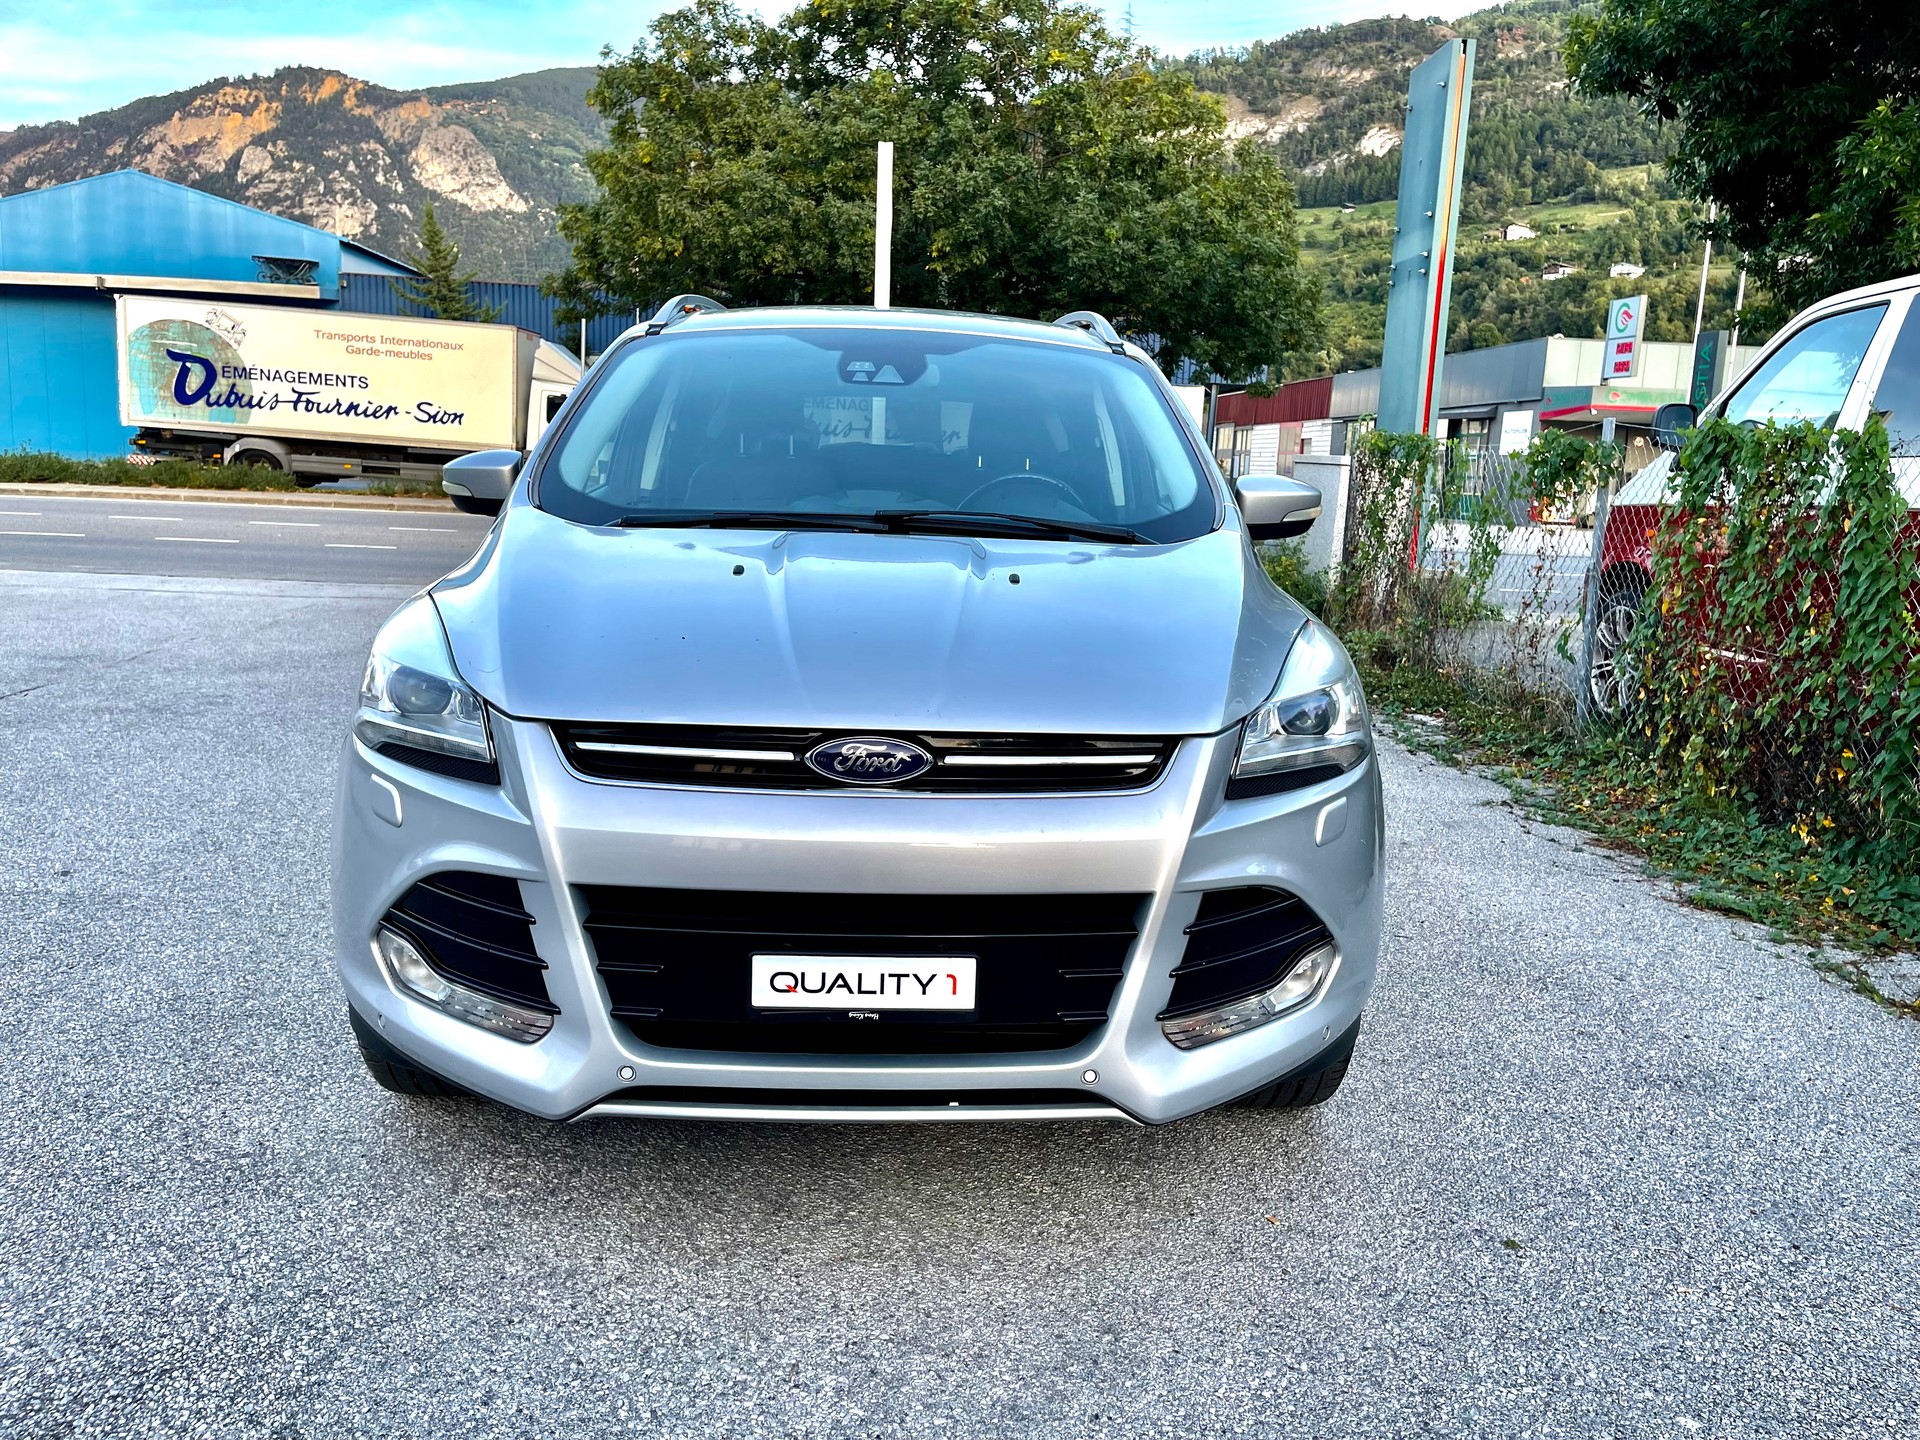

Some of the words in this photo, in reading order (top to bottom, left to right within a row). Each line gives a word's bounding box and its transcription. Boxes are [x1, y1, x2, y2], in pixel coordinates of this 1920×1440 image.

[313, 329, 377, 344] Transports
[380, 335, 464, 351] Internationaux
[346, 344, 433, 361] Garde-meubles
[413, 401, 464, 425] Sion
[834, 743, 912, 772] Ford
[769, 971, 938, 996] QUALITY
[946, 973, 957, 996] 1
